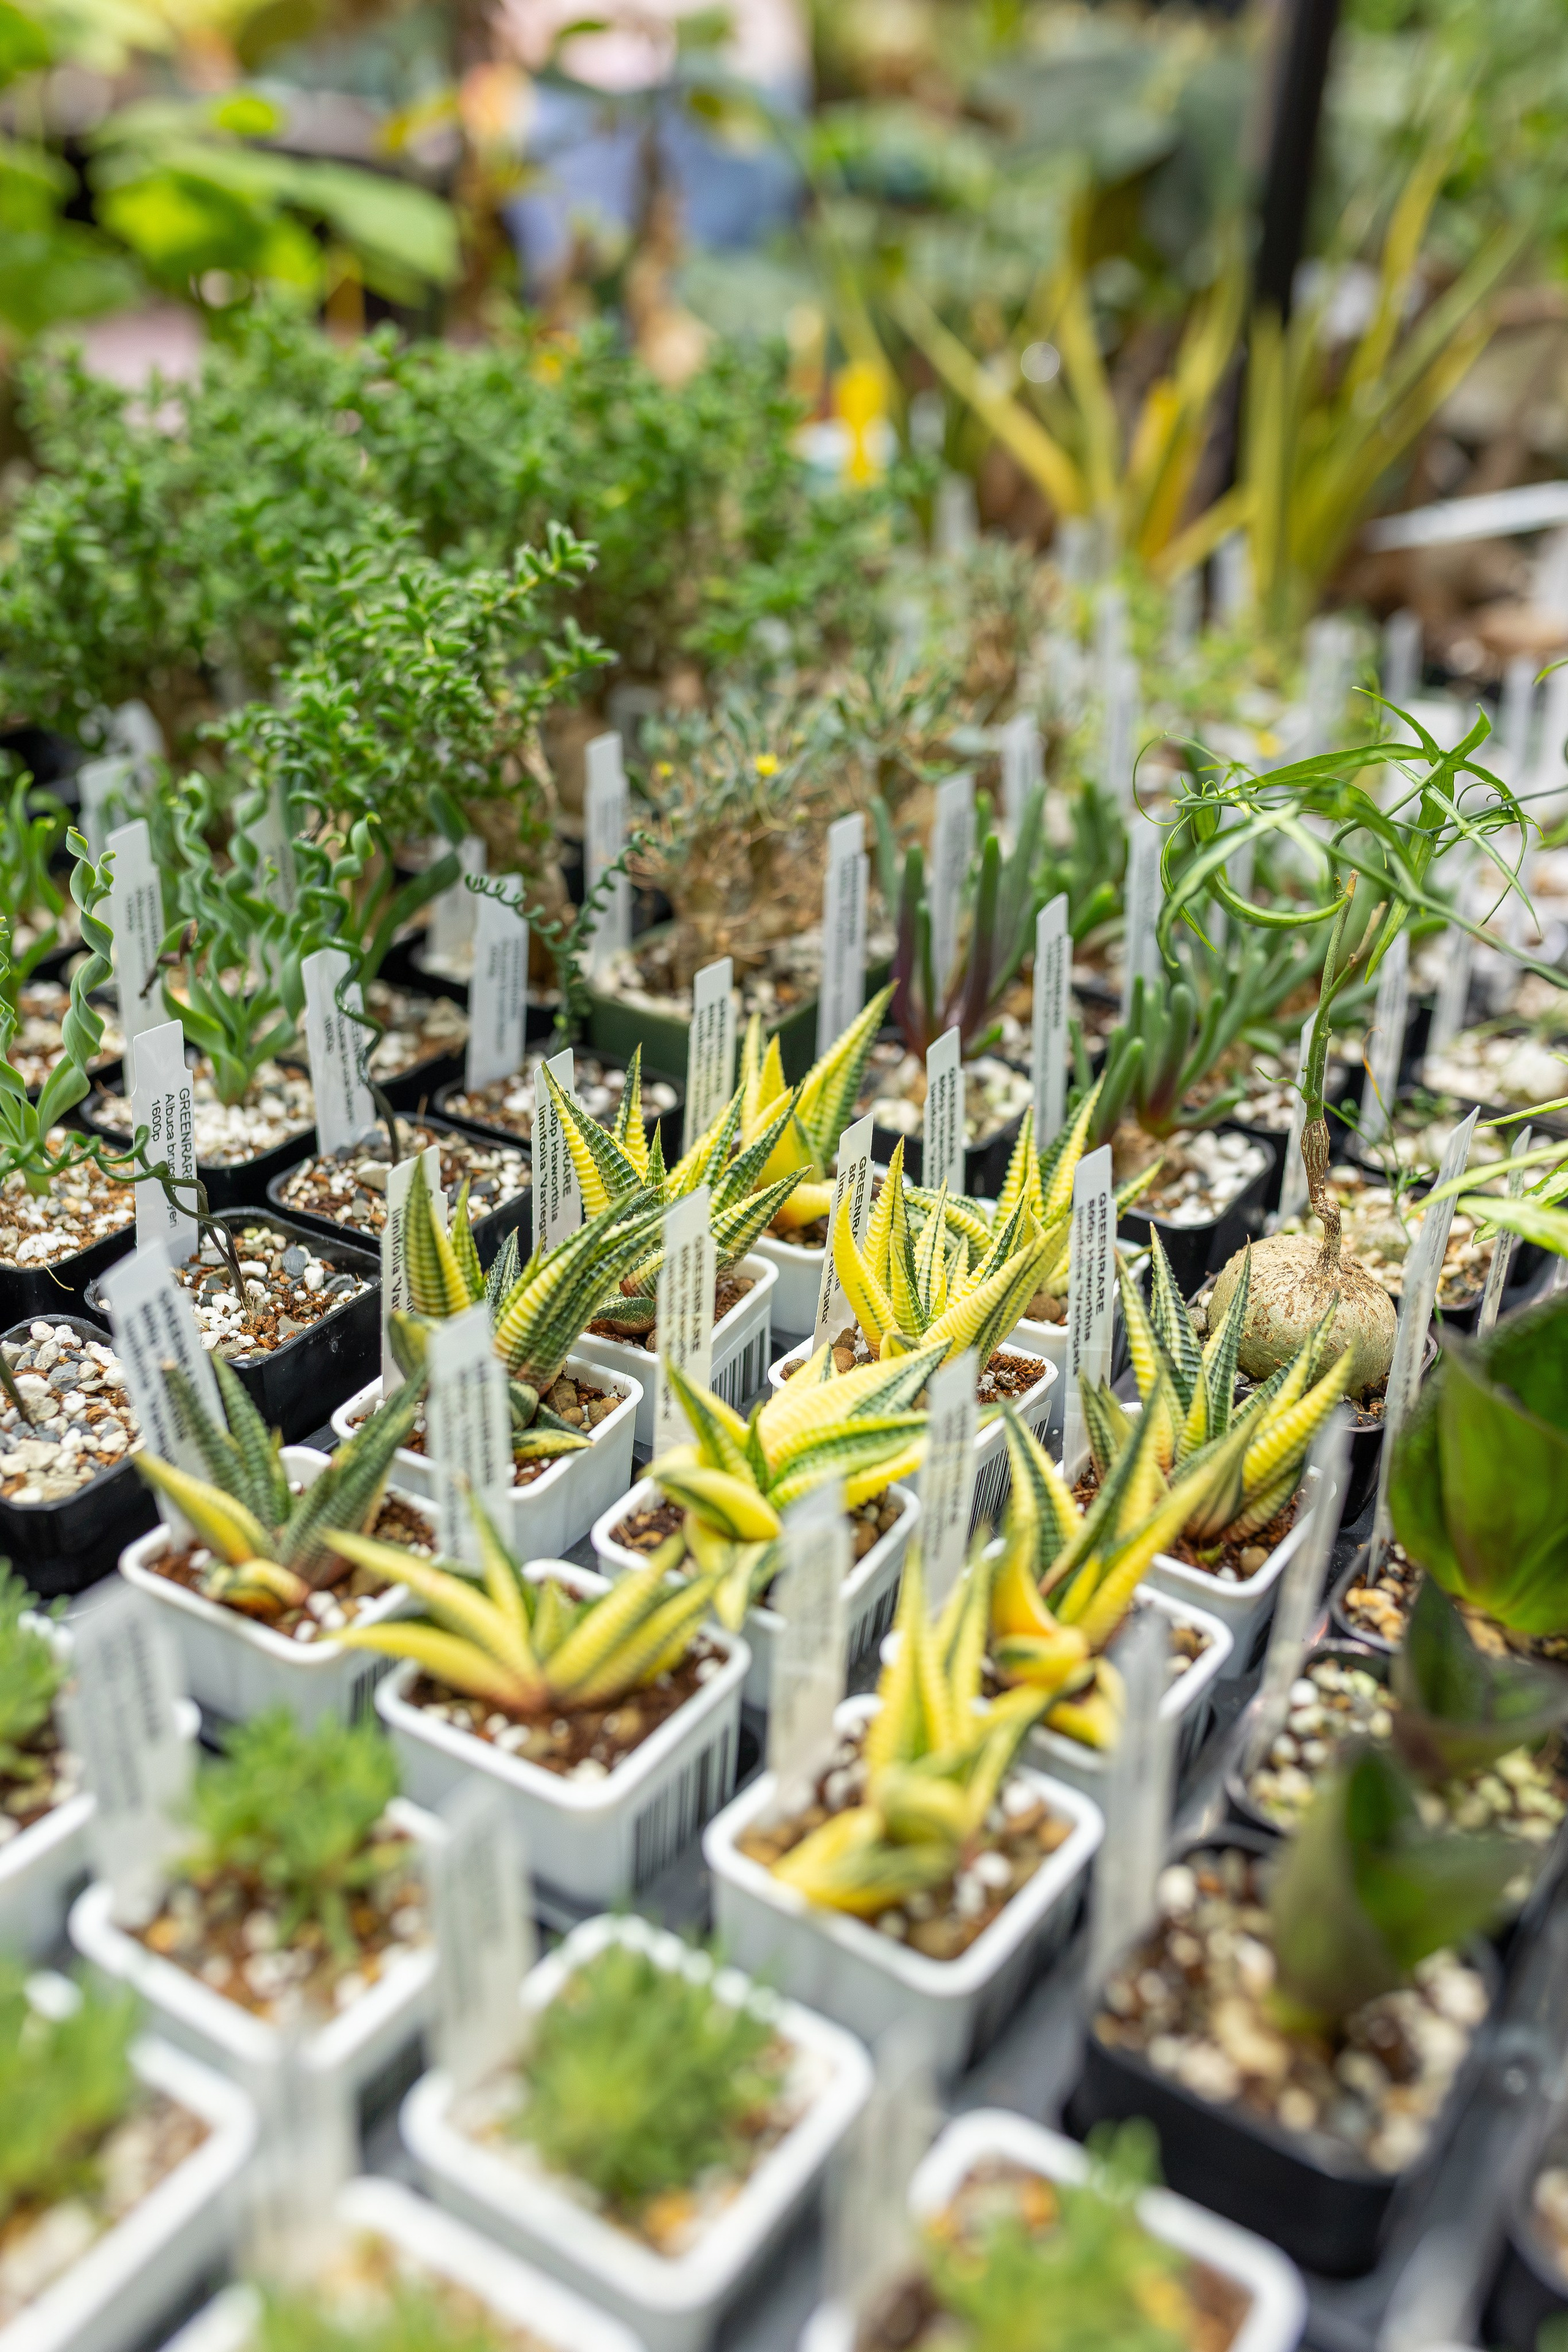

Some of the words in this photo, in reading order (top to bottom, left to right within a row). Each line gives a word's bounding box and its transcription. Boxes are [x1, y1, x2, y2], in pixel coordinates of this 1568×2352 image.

[152, 1099, 162, 1142] 1600p
[165, 1093, 176, 1140] Albuca
[538, 1104, 548, 1172] limifolia
[551, 1139, 560, 1222] Haworthia
[851, 1156, 867, 1246] GREENRA
[392, 1208, 402, 1276] limifolia
[1096, 1193, 1106, 1316] GREENRARE
[821, 1251, 834, 1324] ariegata'
[1084, 1247, 1095, 1341] Haworthia
